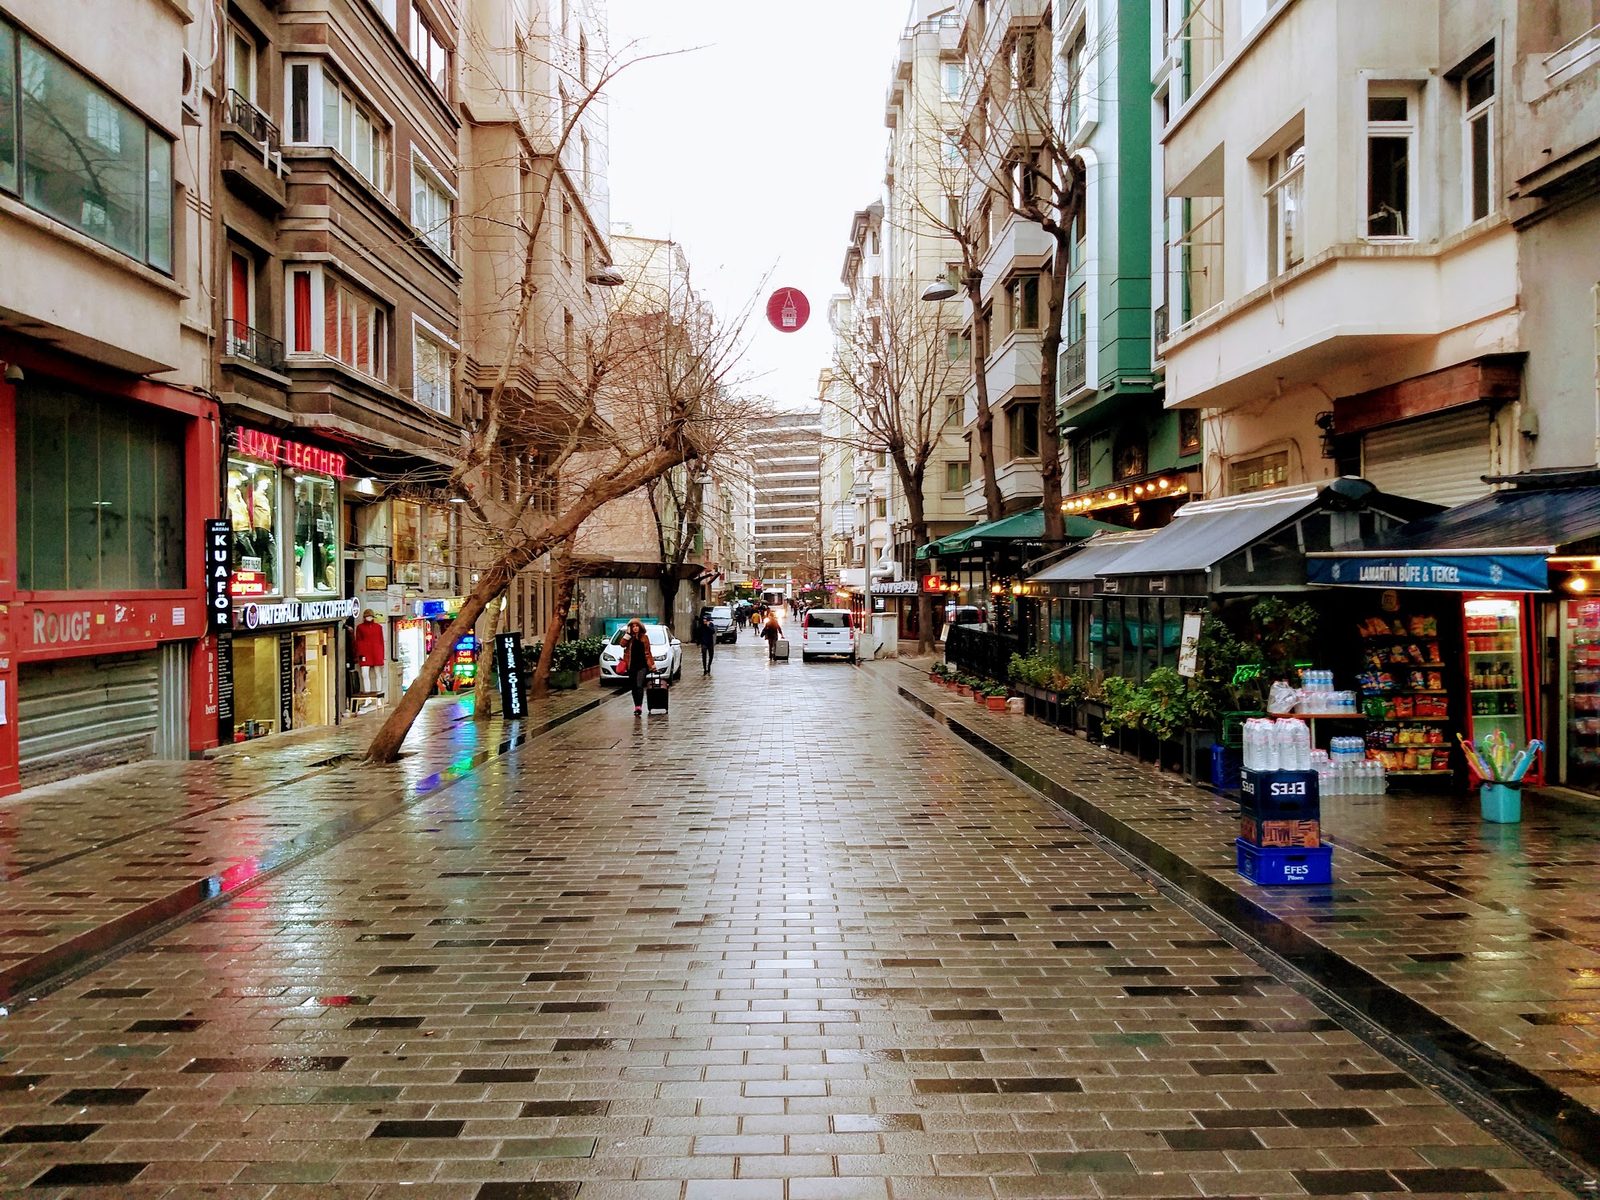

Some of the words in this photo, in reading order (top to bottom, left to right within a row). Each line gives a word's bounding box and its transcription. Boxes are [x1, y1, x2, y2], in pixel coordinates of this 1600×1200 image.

[236, 426, 280, 464] LUXY
[285, 440, 345, 478] LEATHER
[214, 534, 229, 624] KUAFÖR
[1423, 567, 1429, 582] &
[1431, 566, 1460, 583] TEKEL
[258, 603, 299, 625] WATERFALL
[300, 601, 324, 621] UNISEX
[33, 608, 91, 645] ROUGE
[504, 637, 516, 669] UNISEX
[205, 704, 217, 715] beer
[1270, 781, 1306, 796] EFES
[1284, 865, 1309, 874] EFES
